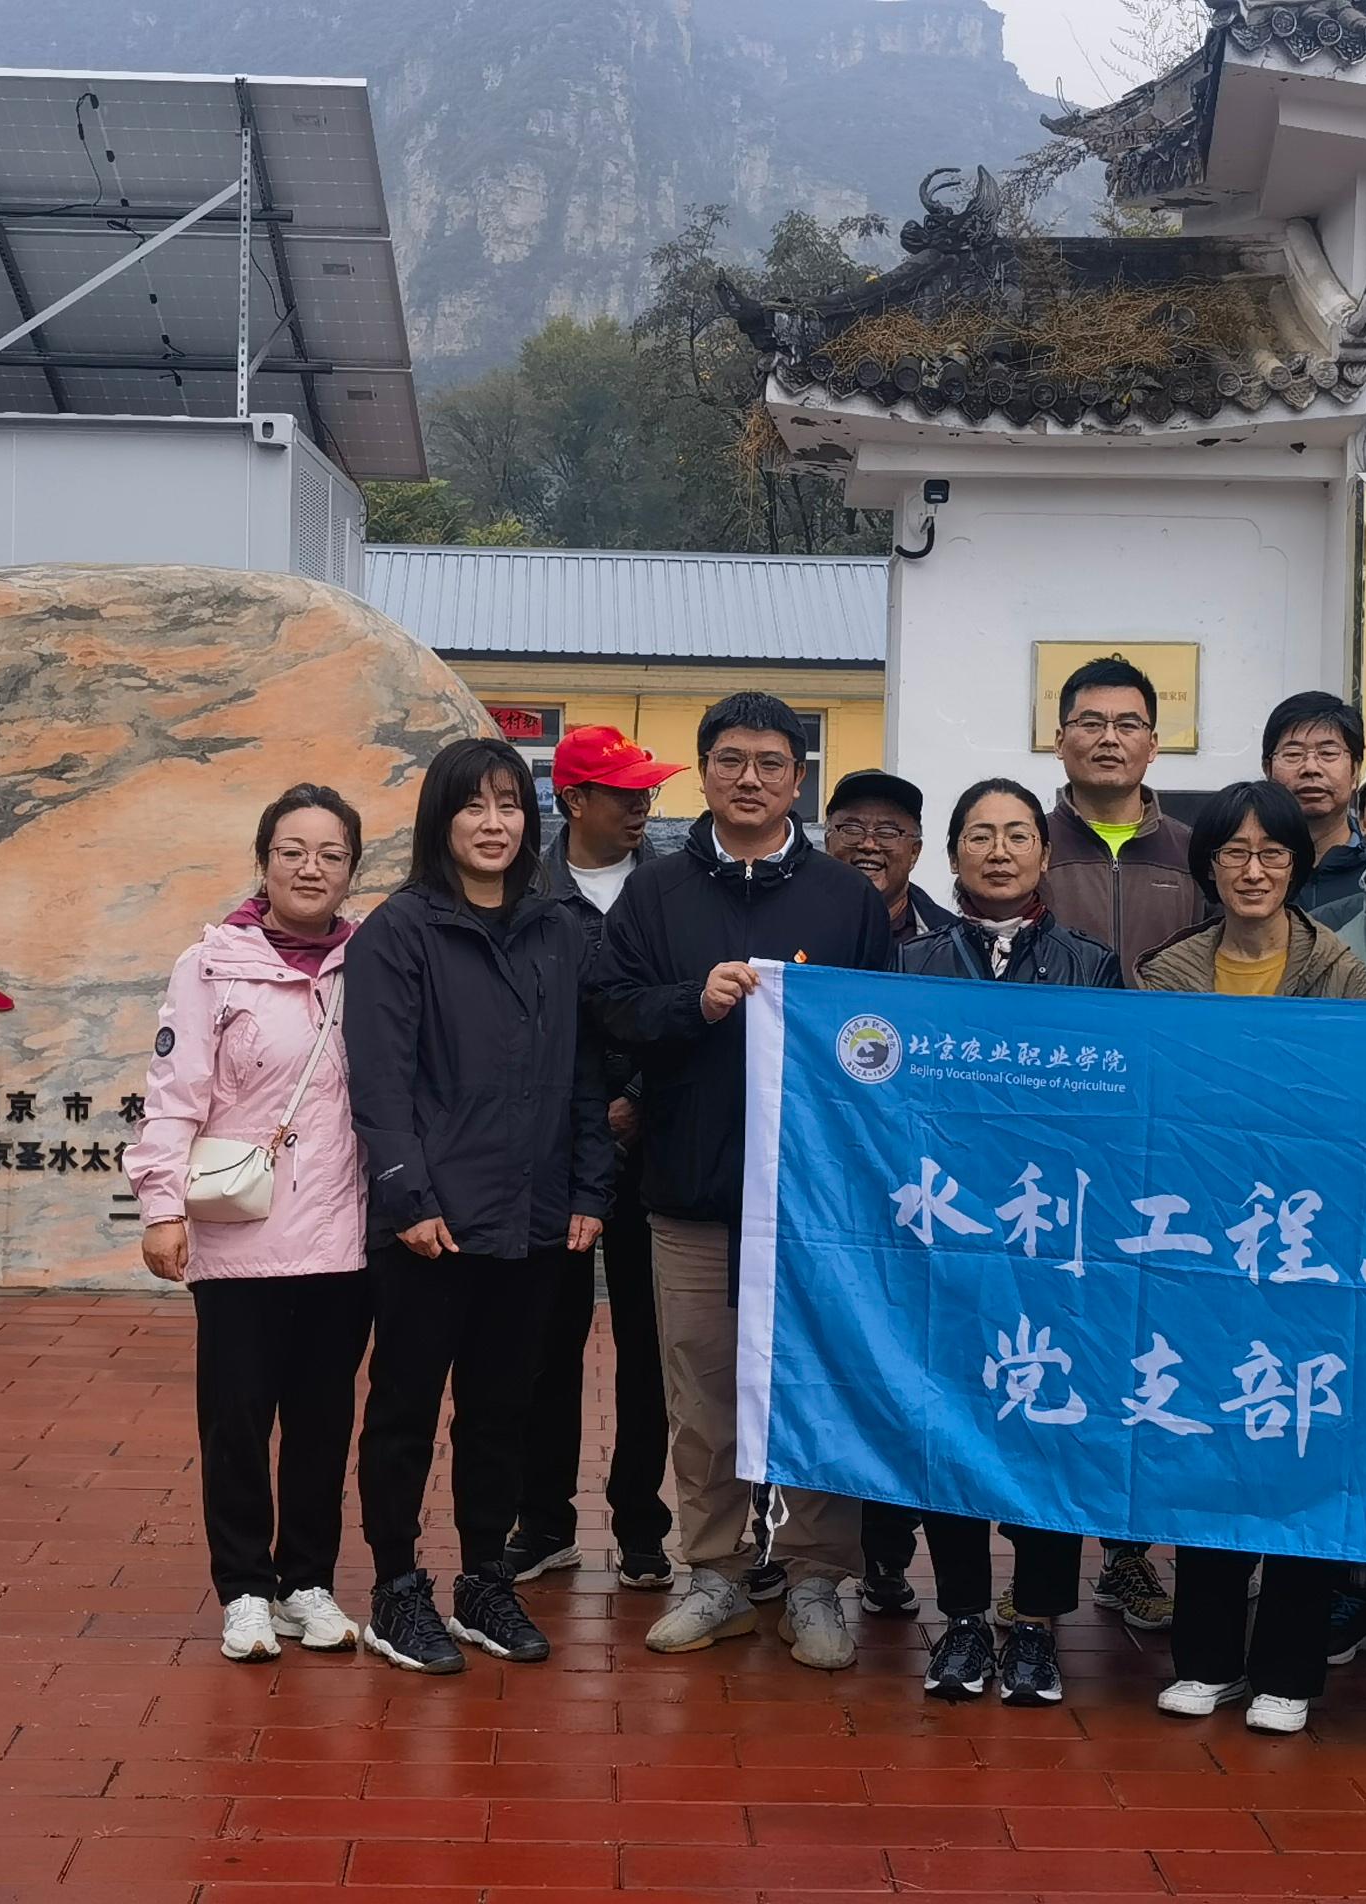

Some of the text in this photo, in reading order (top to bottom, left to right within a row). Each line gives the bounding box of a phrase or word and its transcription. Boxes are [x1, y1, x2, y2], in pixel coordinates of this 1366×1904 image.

[908, 1033, 1127, 1073] 北京农业职业学院
[945, 1067, 1003, 1083] Vocational
[1004, 1072, 1047, 1090] College
[1049, 1077, 1062, 1088] of
[1062, 1078, 1126, 1093] Agriculture
[983, 1313, 1348, 1459] 党支部
